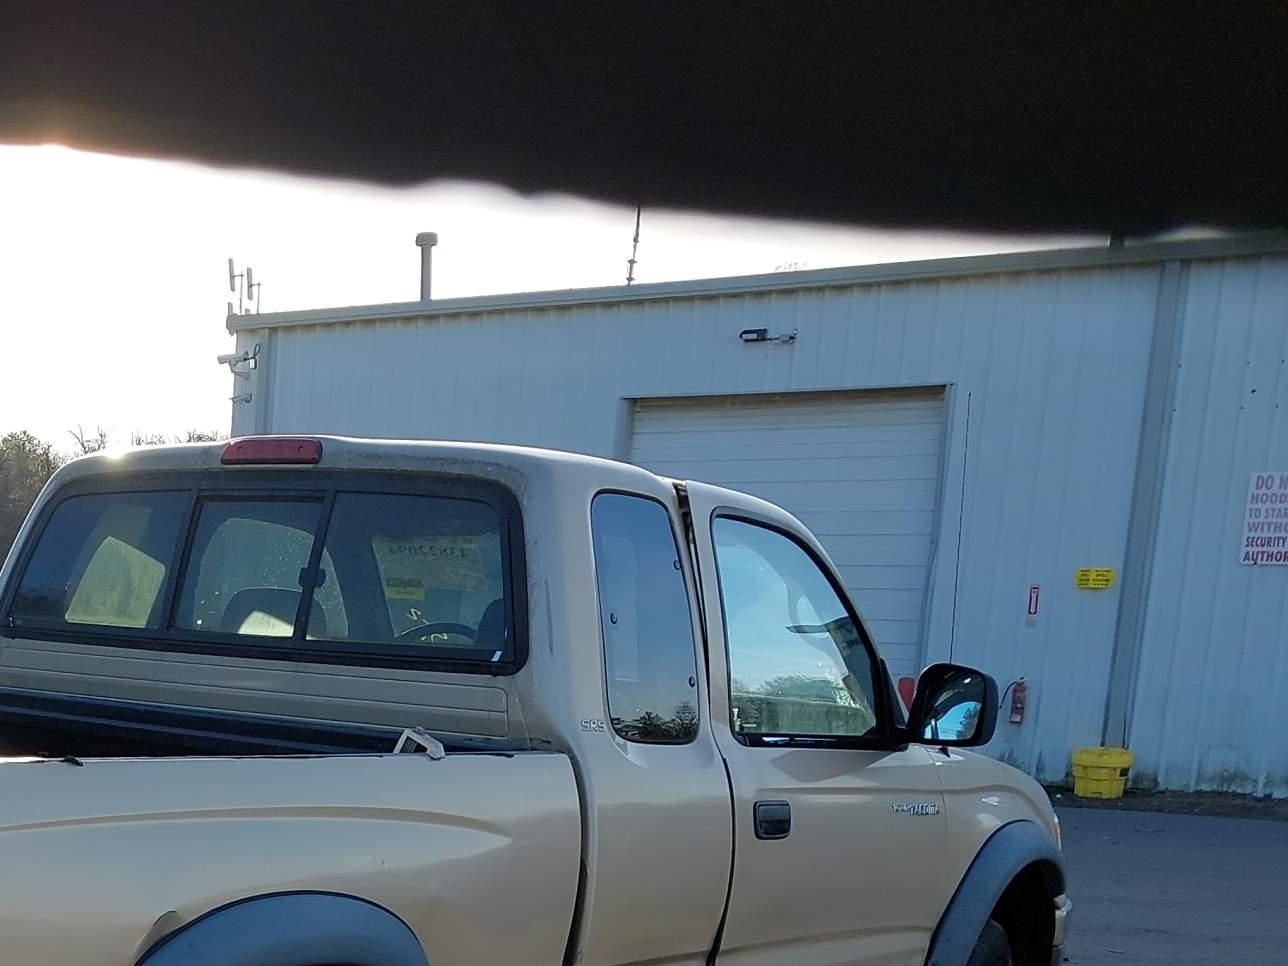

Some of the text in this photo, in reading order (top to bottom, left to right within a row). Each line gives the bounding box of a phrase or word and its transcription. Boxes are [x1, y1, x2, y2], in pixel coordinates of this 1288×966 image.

[1255, 474, 1274, 490] DO
[1250, 493, 1288, 504] HOOD
[1248, 507, 1261, 519] TO
[1245, 536, 1287, 548] SECURITY
